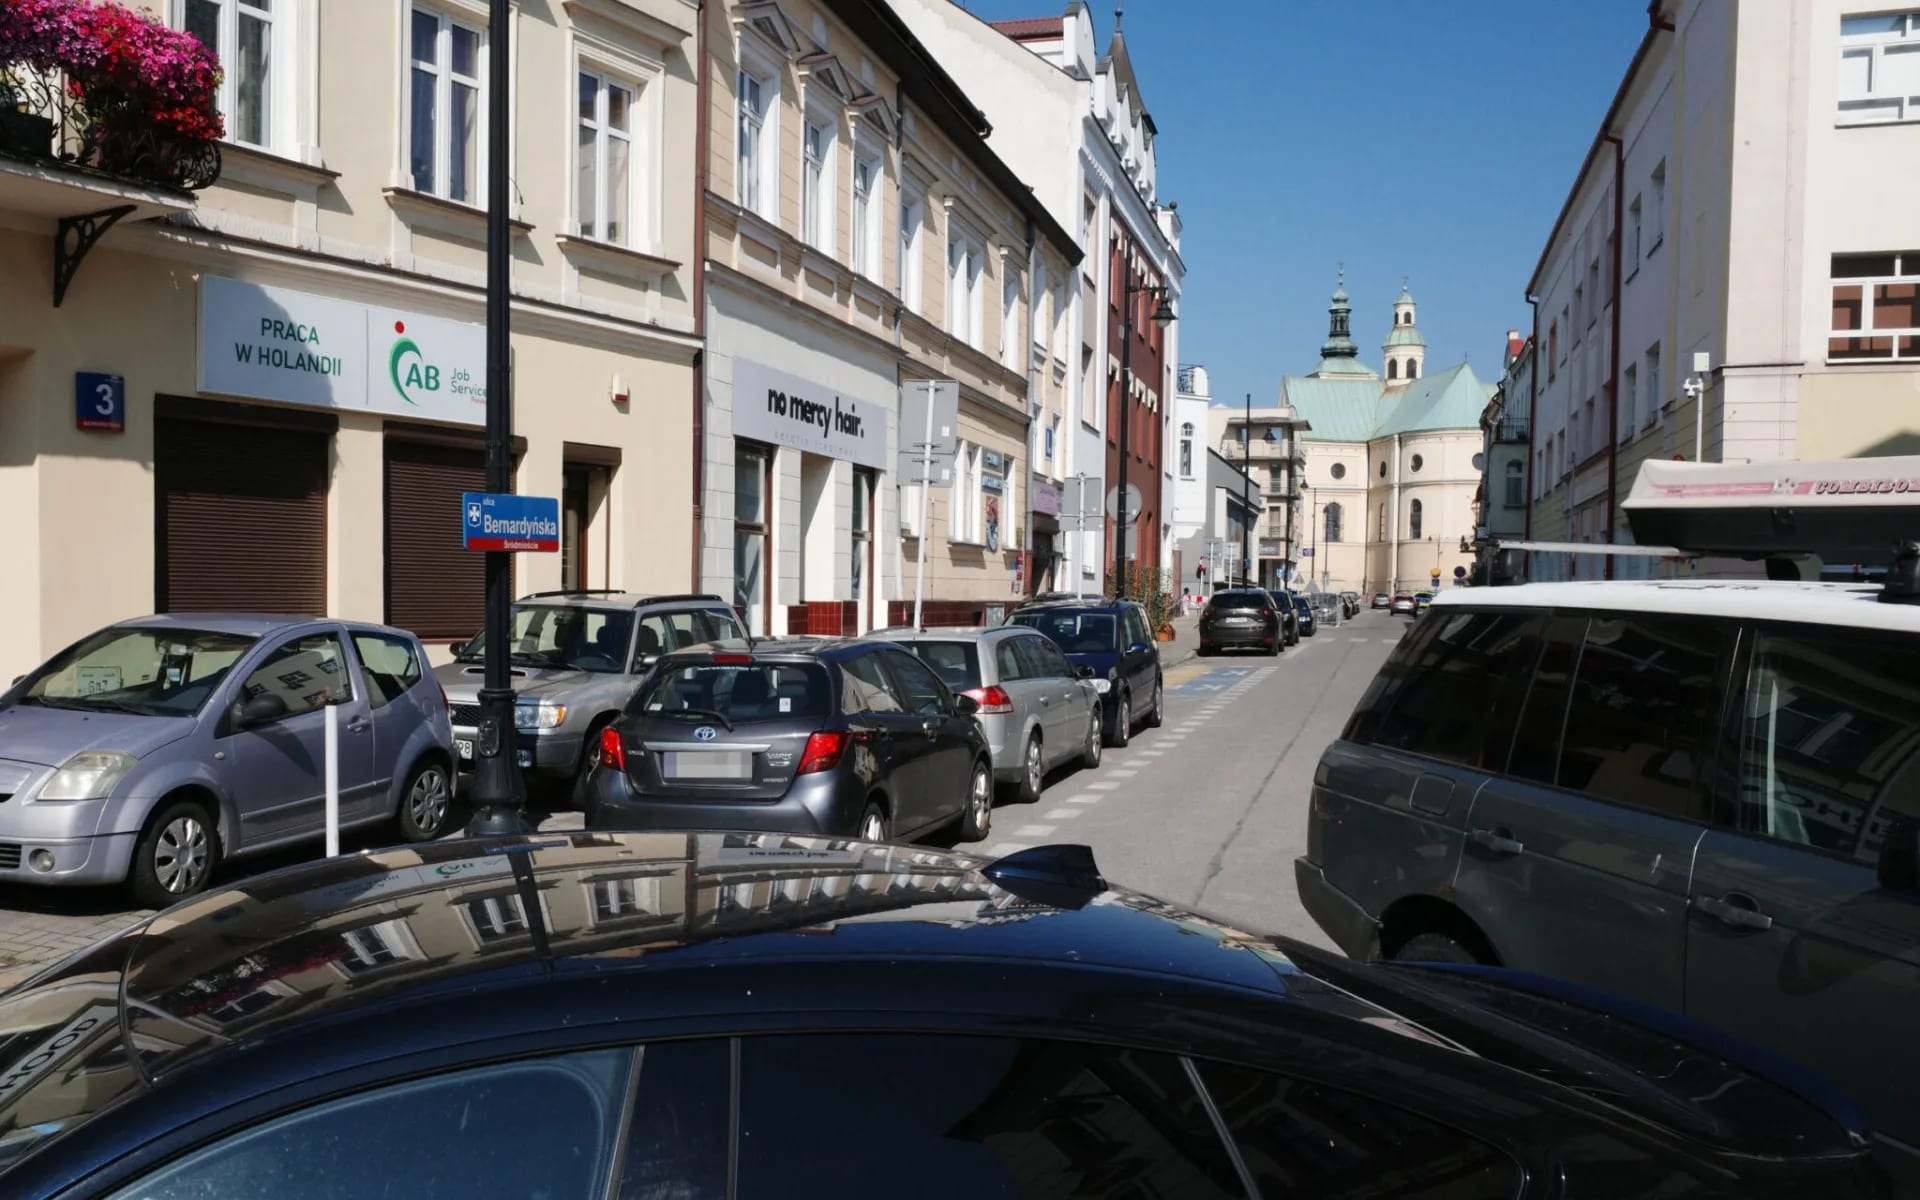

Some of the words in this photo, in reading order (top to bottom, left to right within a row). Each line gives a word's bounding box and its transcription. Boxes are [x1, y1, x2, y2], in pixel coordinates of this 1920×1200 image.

[261, 317, 320, 345] PRACA
[235, 341, 253, 364] W
[258, 346, 342, 376] HOLANDII
[450, 367, 470, 381] Job
[95, 383, 114, 416] 3
[767, 388, 786, 417] no
[789, 395, 832, 439] mercy
[835, 396, 864, 438] hair.
[483, 514, 557, 540] Bernardyńska
